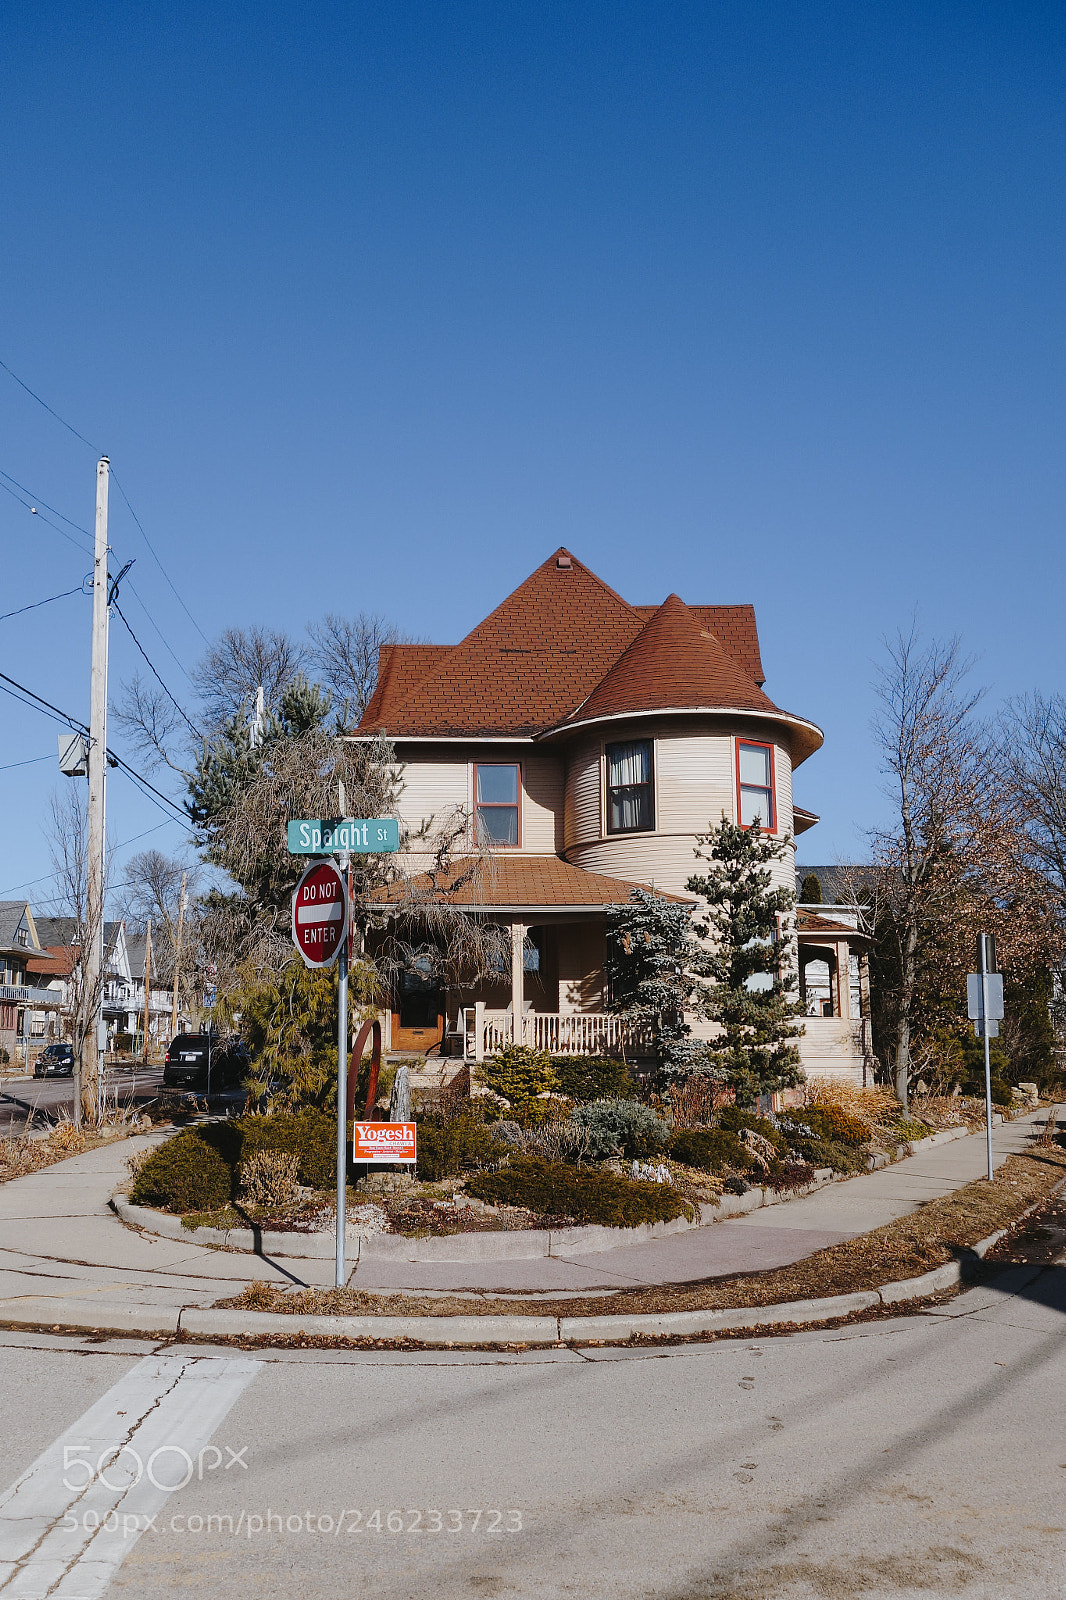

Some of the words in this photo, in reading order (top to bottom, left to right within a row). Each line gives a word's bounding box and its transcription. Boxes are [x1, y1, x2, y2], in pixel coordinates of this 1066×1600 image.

[299, 823, 369, 851] Spaight
[377, 829, 388, 841] St
[303, 885, 317, 901] DO
[319, 881, 337, 900] NOT
[304, 927, 336, 944] ENTER
[356, 1125, 414, 1142] Yogesh
